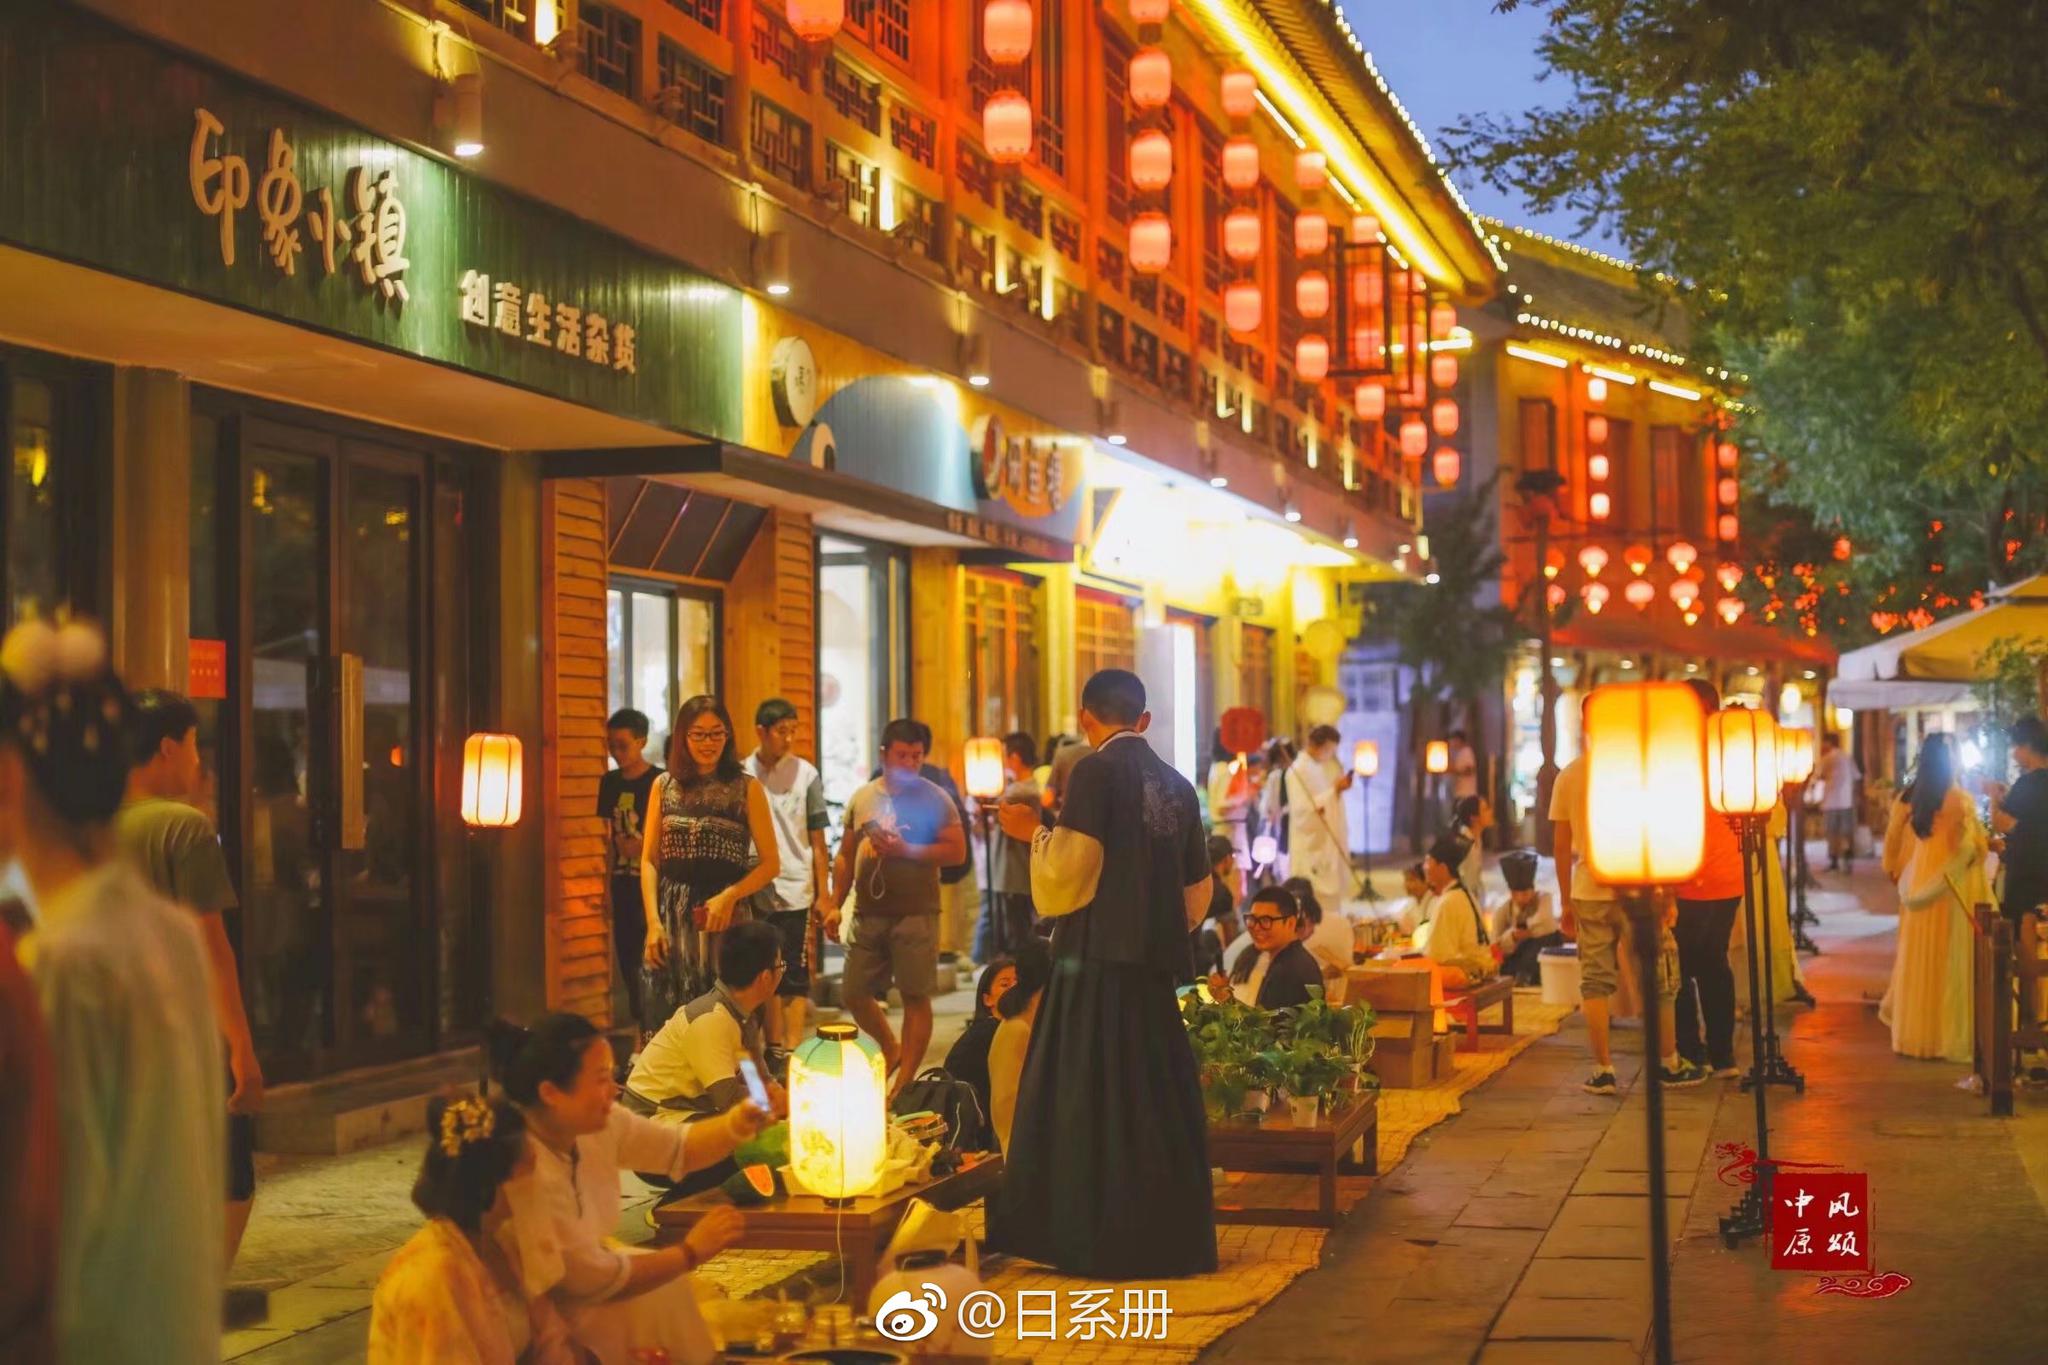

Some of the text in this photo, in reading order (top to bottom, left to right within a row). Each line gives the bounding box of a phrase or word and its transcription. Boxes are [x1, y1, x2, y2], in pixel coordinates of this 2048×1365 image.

[189, 108, 410, 302] 印象小镇
[458, 269, 637, 376] 创意生活杂货
